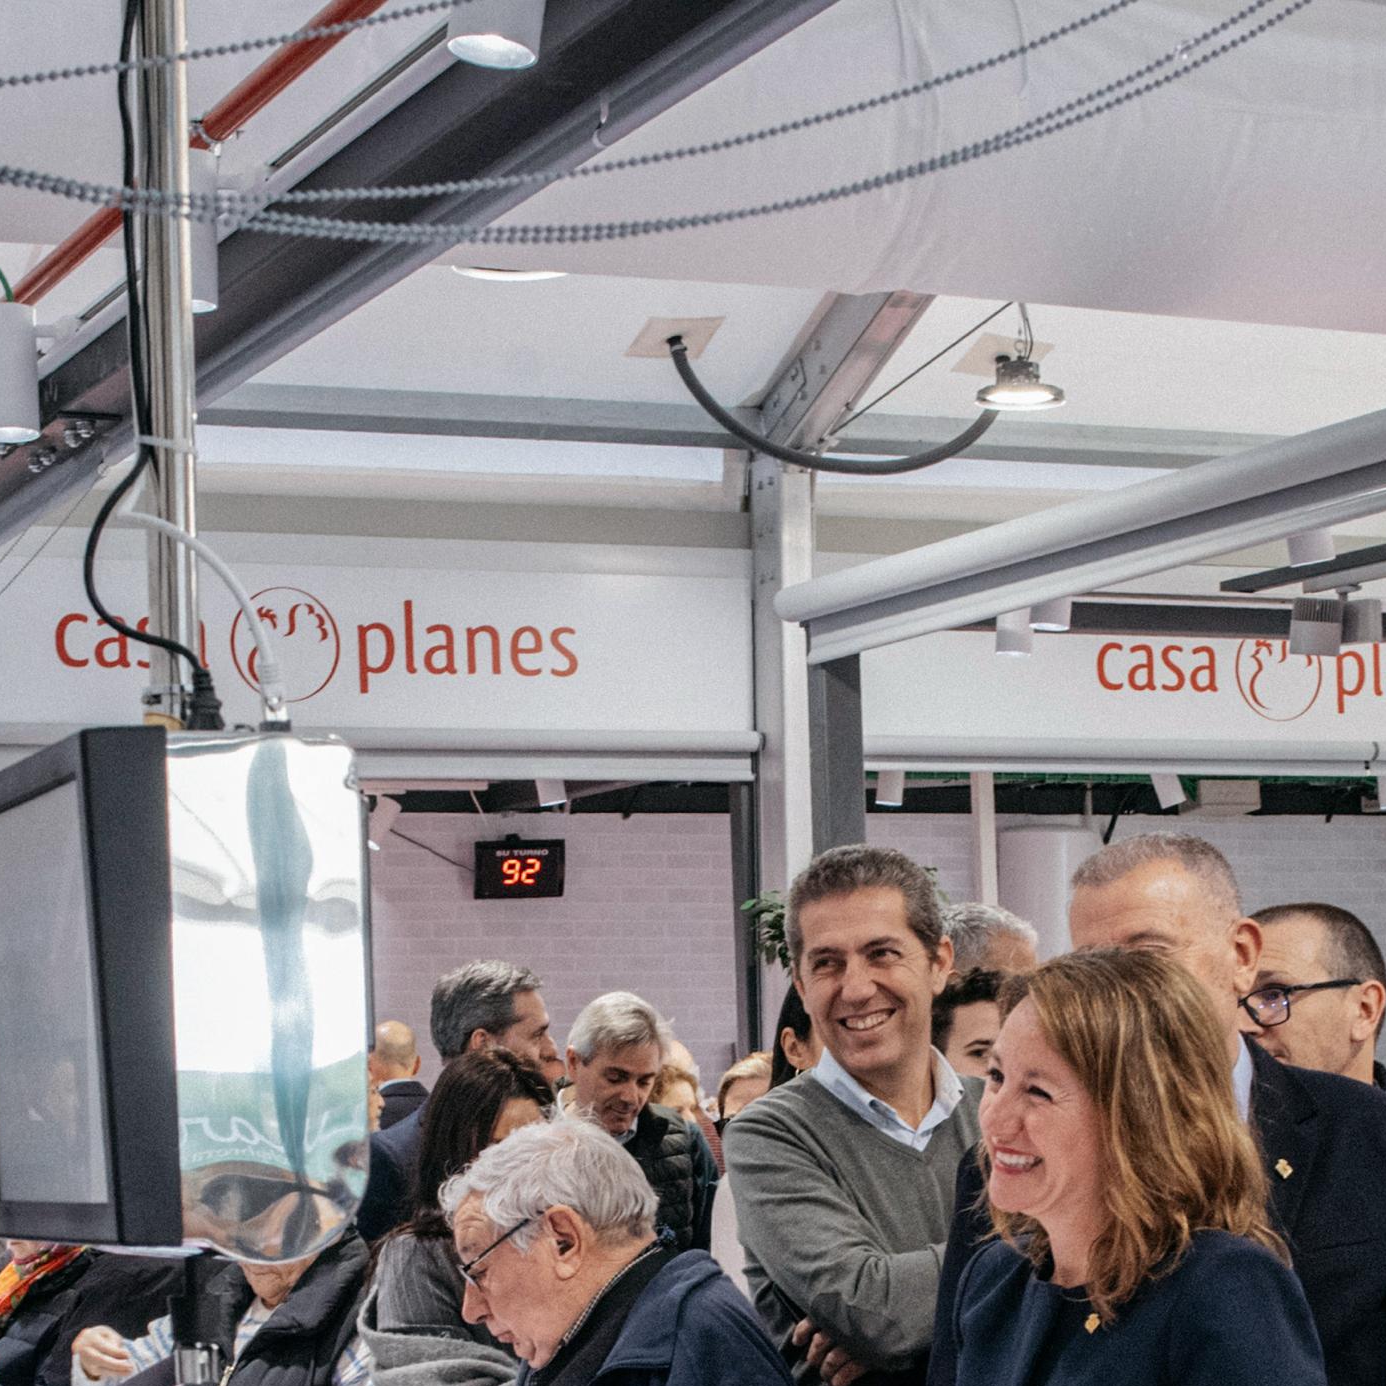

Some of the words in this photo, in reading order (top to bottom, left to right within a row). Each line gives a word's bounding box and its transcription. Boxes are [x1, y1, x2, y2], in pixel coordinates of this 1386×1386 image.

[357, 600, 579, 693] planes
[1096, 639, 1219, 692] casa
[501, 858, 542, 886] 92
[512, 849, 549, 857] TURNO
